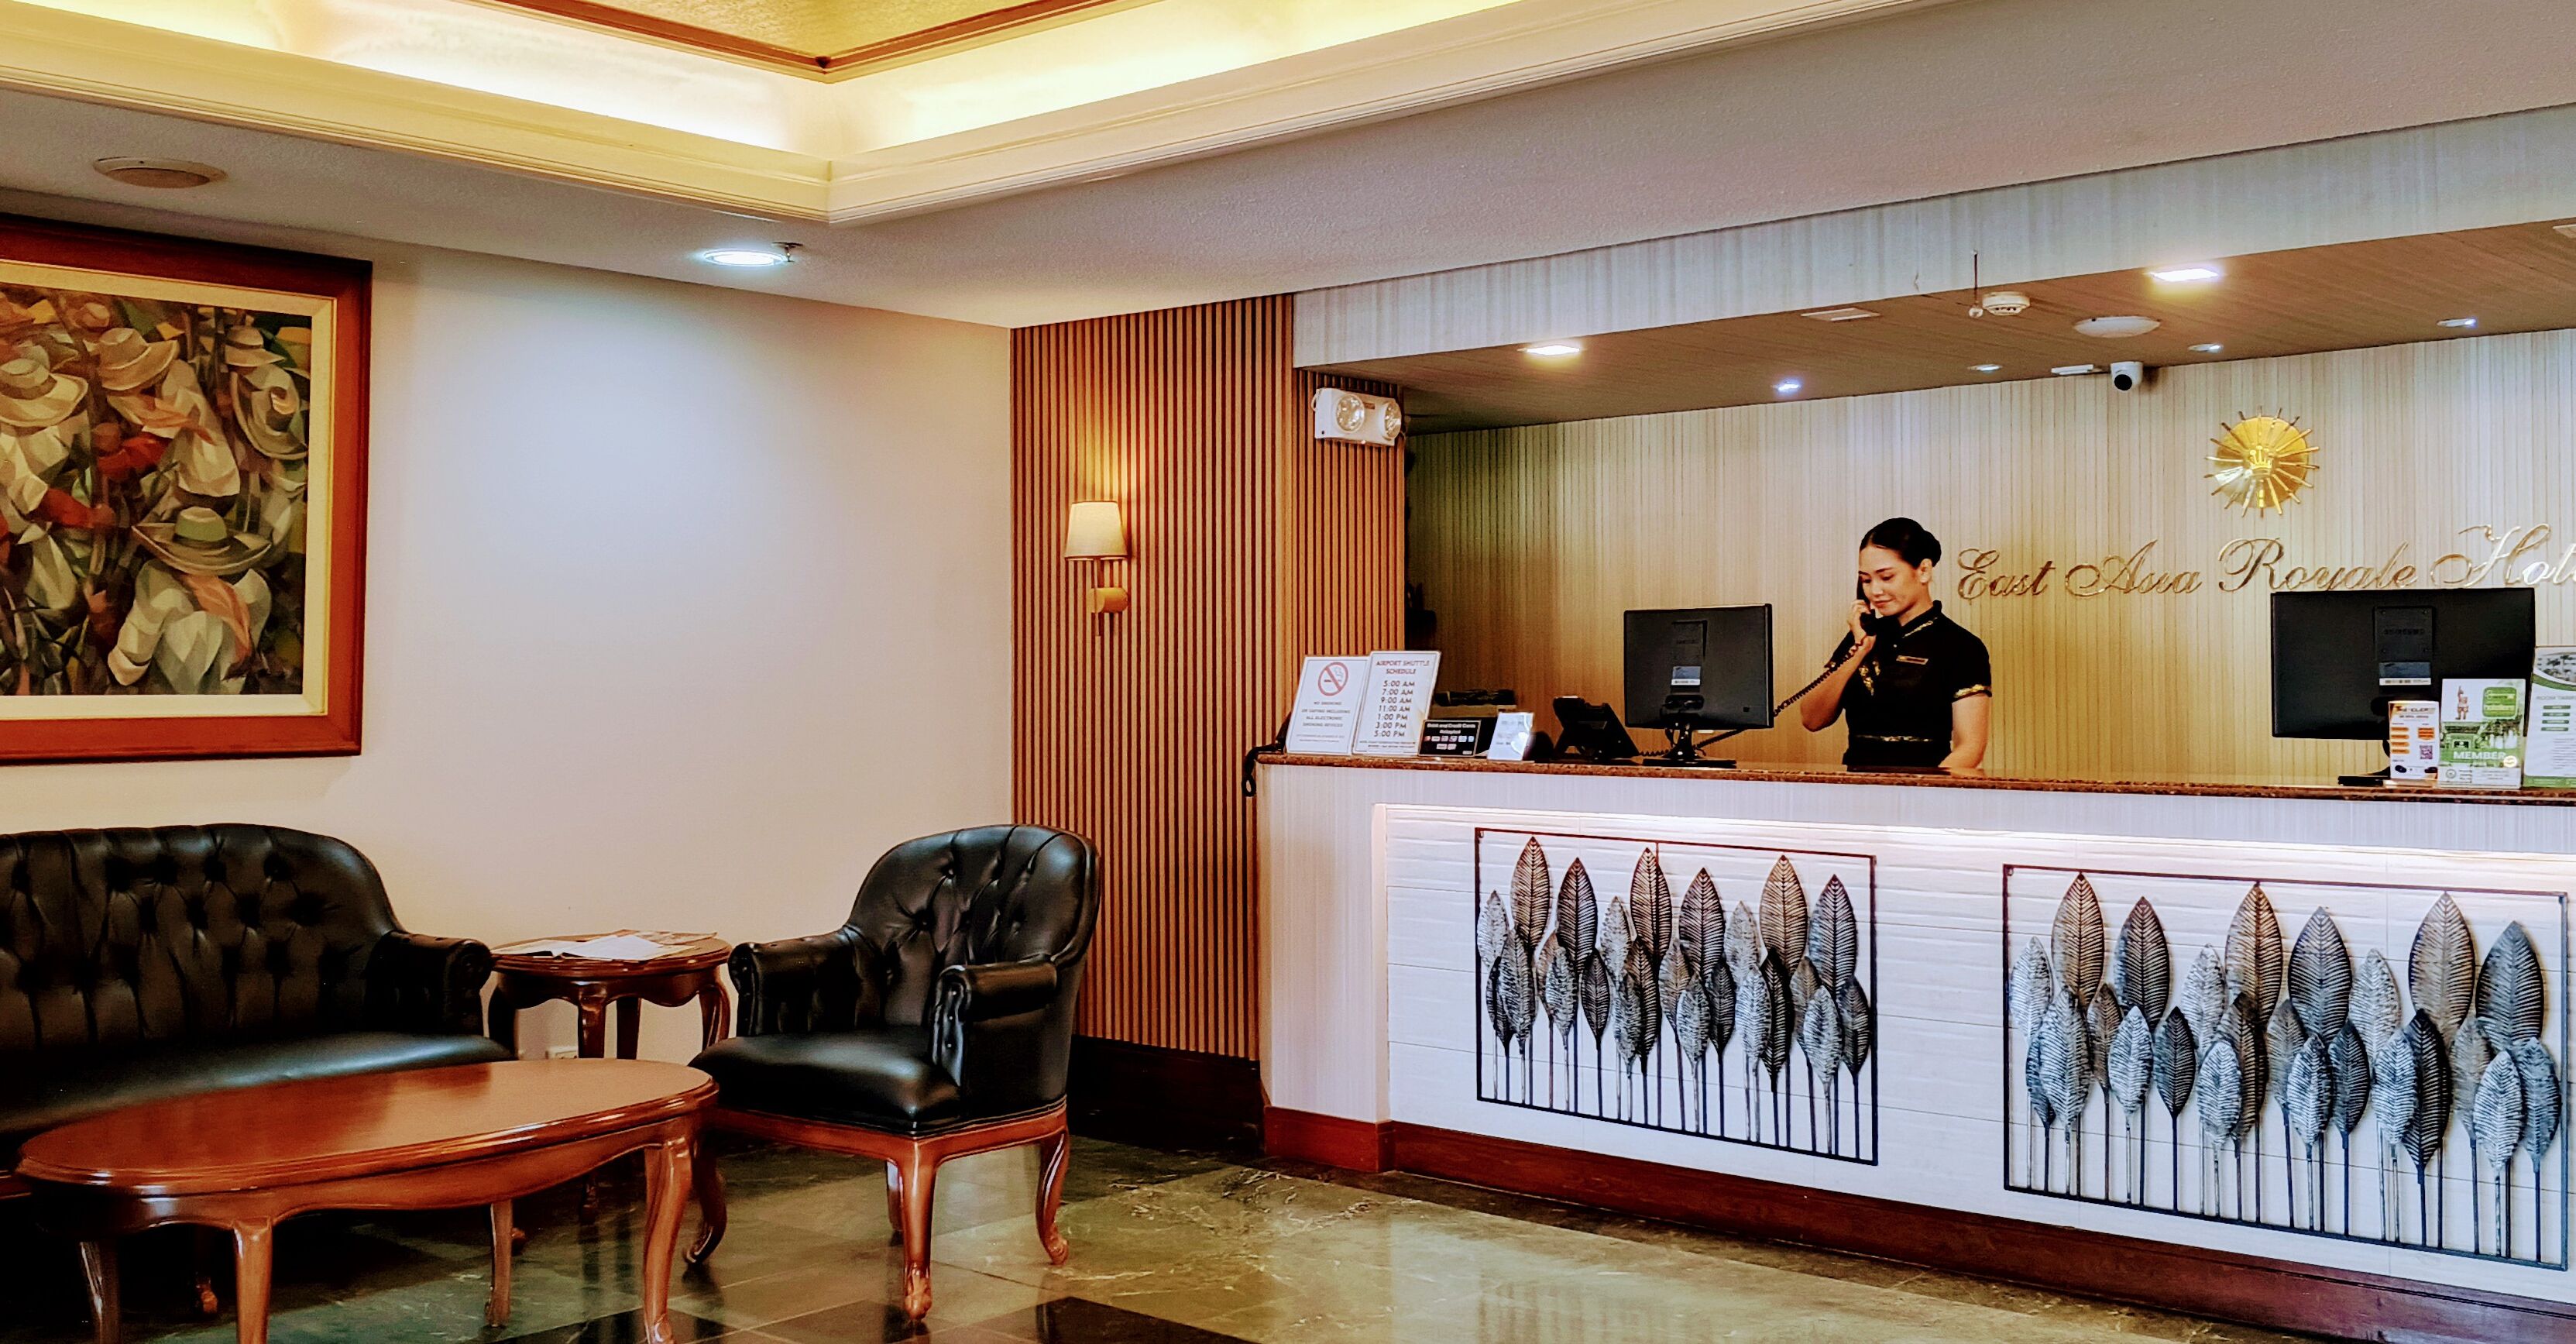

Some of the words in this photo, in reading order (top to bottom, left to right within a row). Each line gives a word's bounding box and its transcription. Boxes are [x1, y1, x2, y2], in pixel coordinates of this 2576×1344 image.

[1957, 548, 2056, 601] East
[2065, 538, 2203, 598] Asia
[2217, 537, 2420, 593] Royale
[2453, 751, 2507, 760] MEMBER
